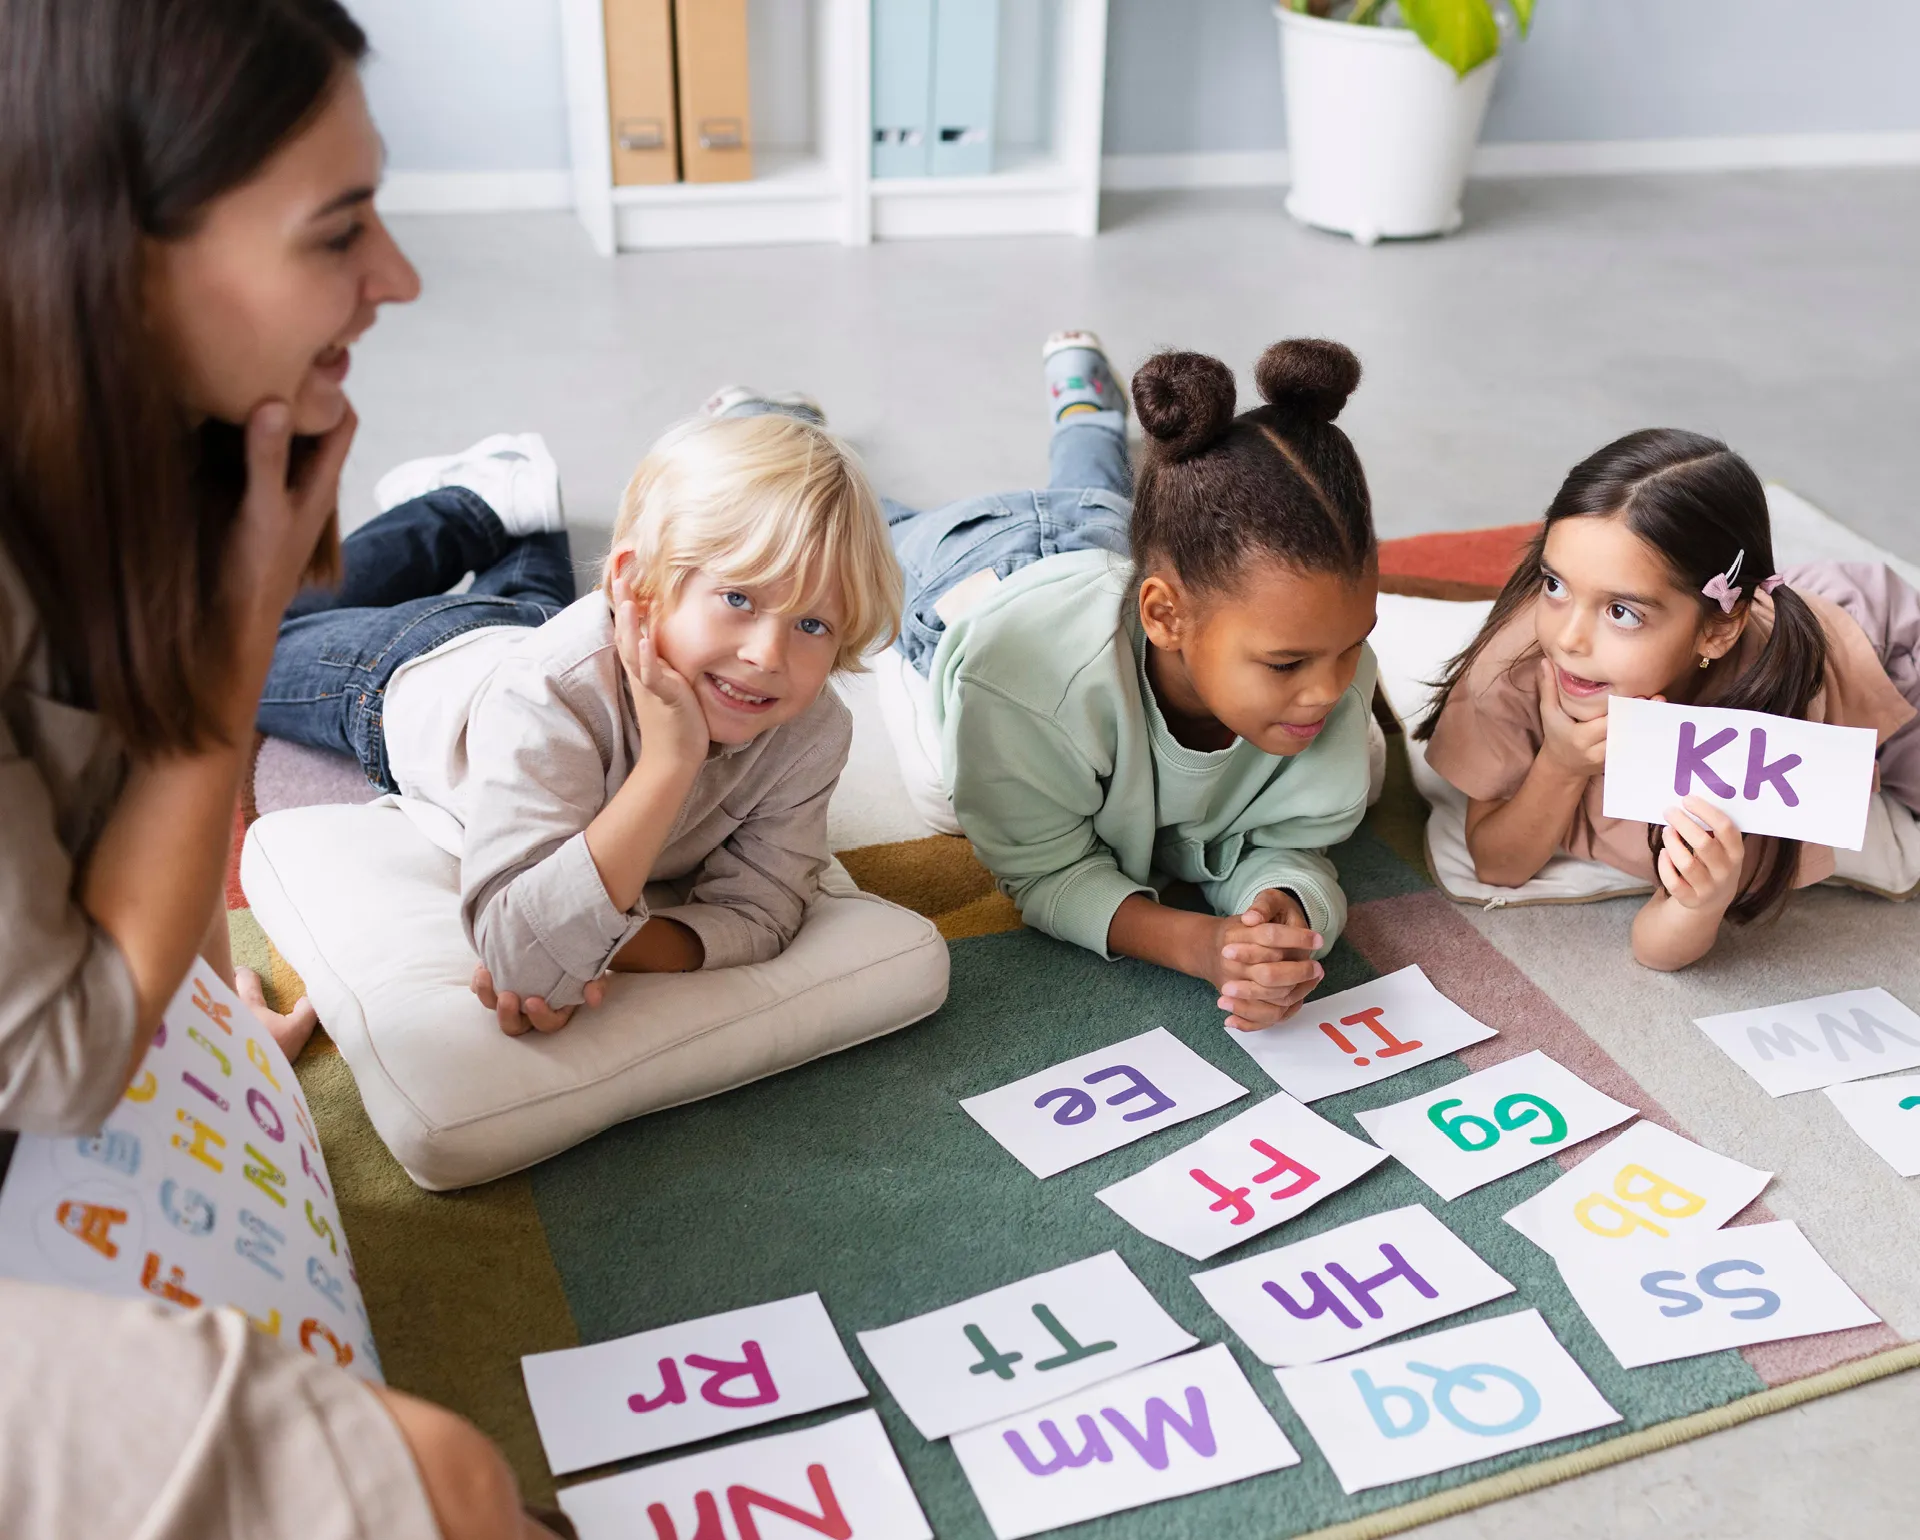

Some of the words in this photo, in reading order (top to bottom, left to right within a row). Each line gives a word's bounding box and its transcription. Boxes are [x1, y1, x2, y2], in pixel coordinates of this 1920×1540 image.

[1674, 722, 1802, 807] Kk
[191, 977, 233, 1036] K
[1319, 1007, 1423, 1066] Ii
[187, 1026, 232, 1077] J
[246, 1037, 281, 1092] P
[182, 1071, 229, 1112] I
[245, 1087, 285, 1142] O
[1034, 1065, 1176, 1125] Ee
[171, 1108, 226, 1173] H
[1427, 1093, 1568, 1152] Gg
[242, 1142, 287, 1208] N
[1189, 1139, 1320, 1226] Ff
[1574, 1163, 1707, 1239] Bb
[56, 1199, 128, 1260] A
[159, 1178, 217, 1237] G
[305, 1199, 338, 1256] S
[235, 1208, 287, 1281] M
[140, 1250, 203, 1310] F
[306, 1256, 346, 1313] R
[1262, 1243, 1439, 1329] Hh
[1640, 1259, 1781, 1319] Ss
[963, 1304, 1117, 1380] Tt
[627, 1340, 780, 1414] Rr
[1353, 1363, 1541, 1439] Qq
[1003, 1386, 1217, 1476] Mm
